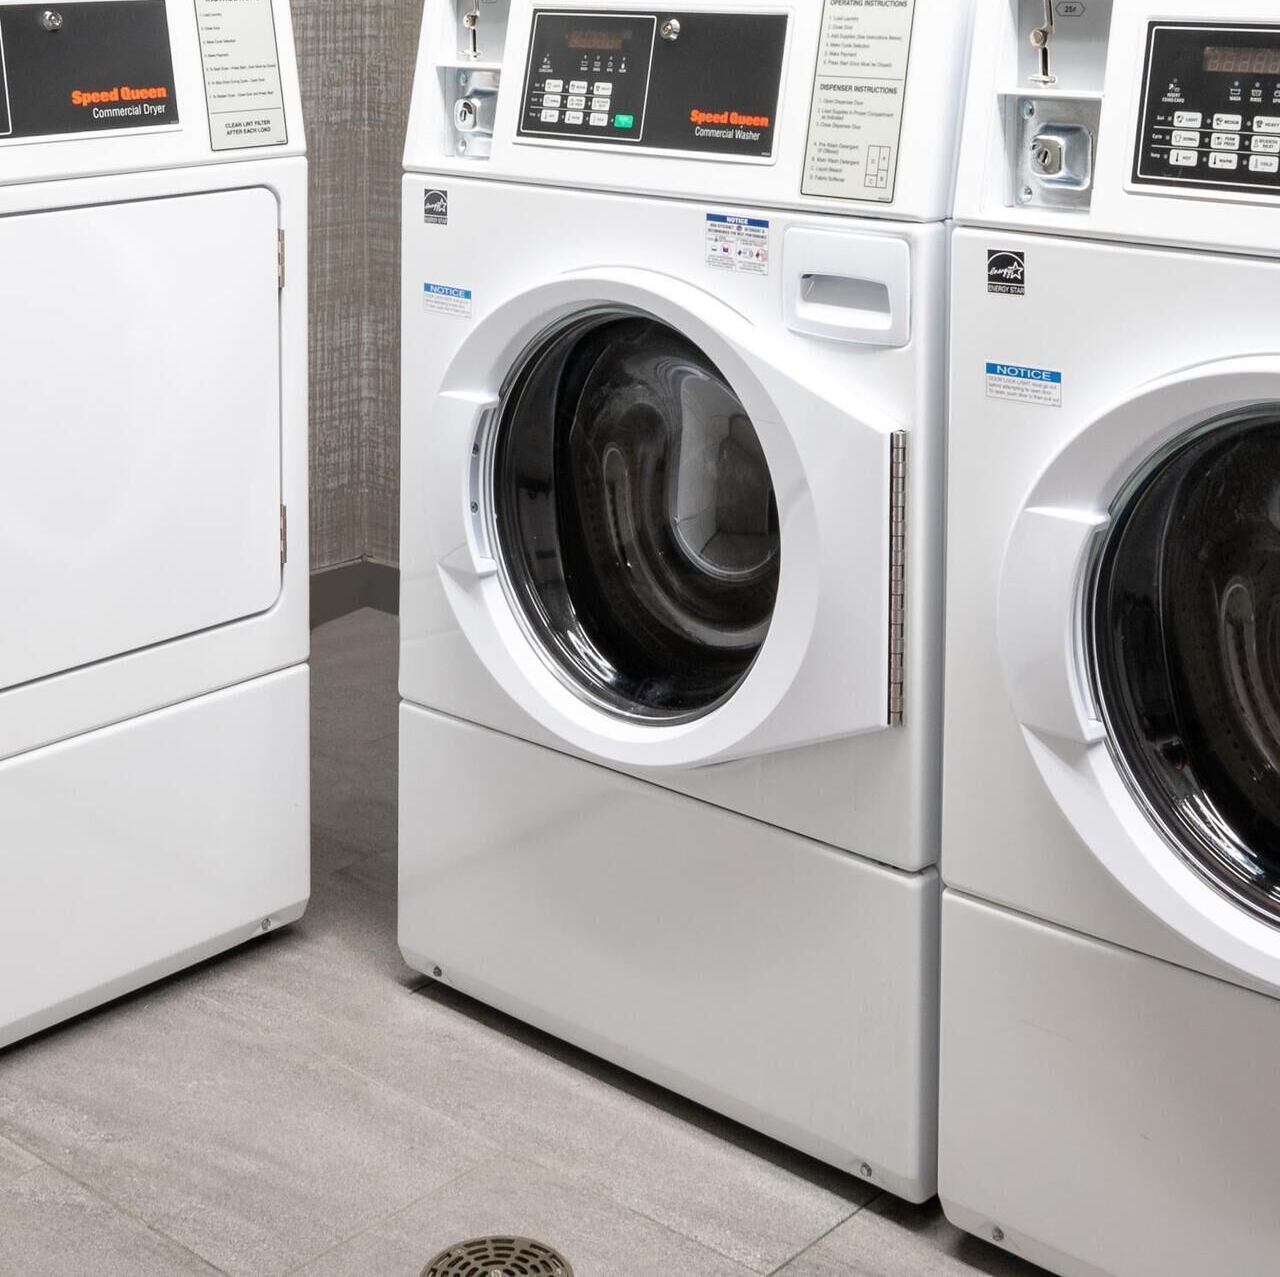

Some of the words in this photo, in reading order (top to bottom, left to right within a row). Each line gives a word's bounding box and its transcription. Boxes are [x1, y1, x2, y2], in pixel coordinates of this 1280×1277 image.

[864, 0, 908, 8] INSTRUCTIONS
[71, 87, 119, 107] Speed
[120, 86, 167, 101] Queen
[819, 83, 853, 92] DISPENSER
[854, 85, 898, 95] INSTRUCTIONS
[92, 104, 142, 119] Commercial
[143, 103, 166, 116] Dryer
[690, 109, 729, 125] Speed
[730, 112, 769, 127] Queen
[695, 126, 734, 139] Commercial
[735, 129, 761, 141] Washer
[430, 284, 466, 299] NOTICE
[988, 284, 1010, 294] ENERGY
[996, 365, 1052, 381] NOTICE
